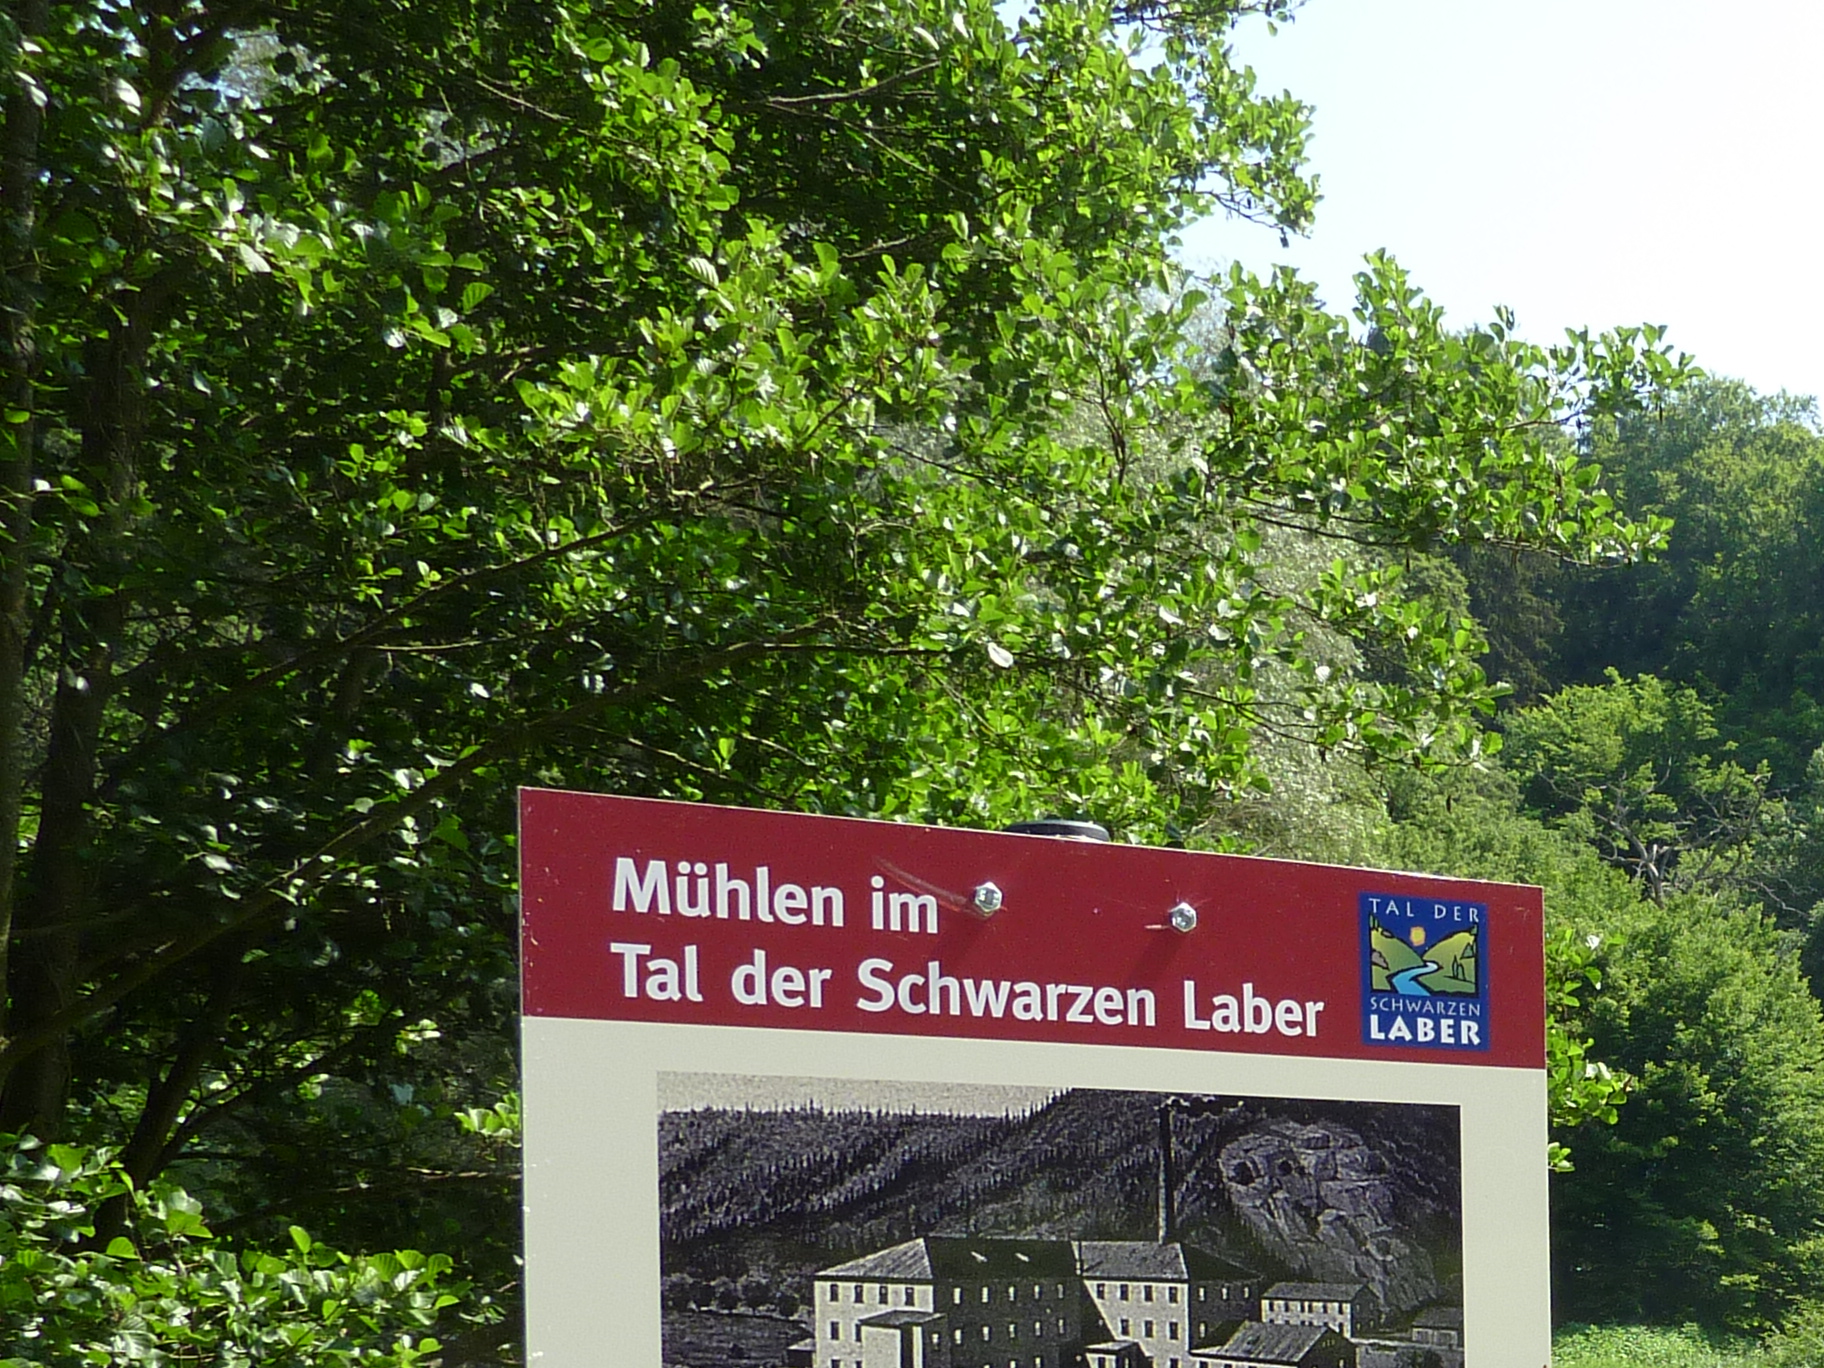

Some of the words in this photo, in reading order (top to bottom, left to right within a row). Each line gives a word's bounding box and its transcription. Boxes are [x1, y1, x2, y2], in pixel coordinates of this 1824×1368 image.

[612, 856, 844, 928] Mühlen
[870, 875, 939, 934] im
[1368, 897, 1415, 918] TAL
[1434, 903, 1480, 923] DER
[610, 942, 704, 1002] Tal
[731, 948, 833, 1008] der
[856, 957, 1156, 1027] Schwarzen
[1183, 979, 1325, 1038] Laber
[1370, 996, 1481, 1017] SCHWARZEN
[1369, 1013, 1482, 1046] LABER
